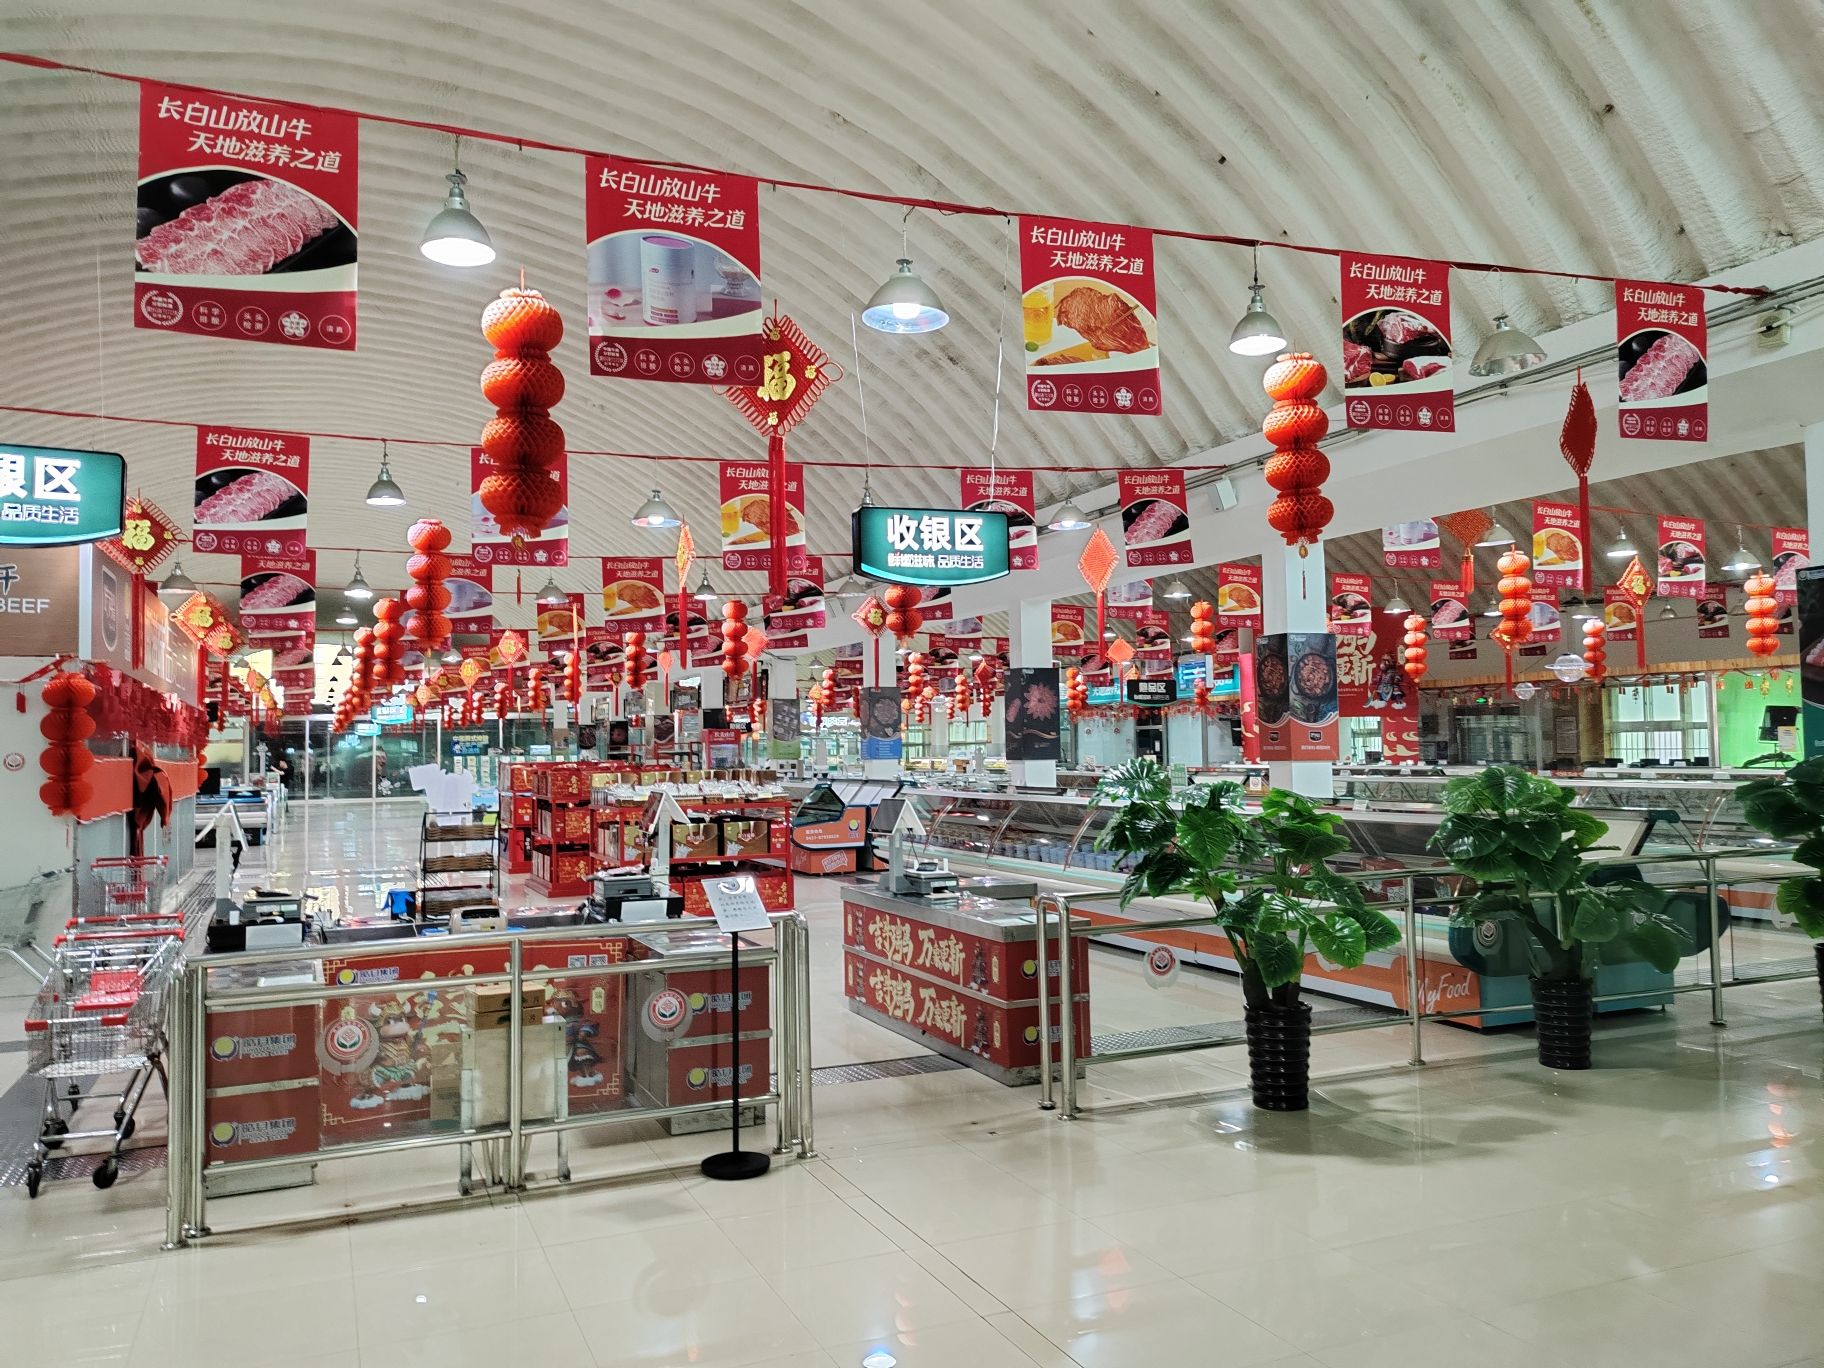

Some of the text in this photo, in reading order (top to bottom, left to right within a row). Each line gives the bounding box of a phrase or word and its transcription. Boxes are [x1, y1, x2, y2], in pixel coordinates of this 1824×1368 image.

[157, 96, 312, 140] 长白山放山牛
[187, 131, 343, 173] 天地滋养之道
[599, 167, 721, 204] 长白山放山牛
[622, 198, 746, 230] 天地滋养之道
[1030, 226, 1126, 251] 长白山放山牛
[1050, 250, 1145, 275] 天地滋养之道
[1349, 261, 1427, 284] 长白山放山牛
[1365, 283, 1443, 306] 天地滋养之道
[1623, 287, 1686, 307] 长白山放山牛
[1637, 307, 1699, 327] 天地滋养之道
[206, 433, 285, 452] 长白山放山牛
[221, 449, 301, 468] 天地滋养之道
[977, 486, 1028, 497] 天地滋养之道
[1124, 475, 1170, 485] 长白山放山牛
[1134, 485, 1181, 495] 天地滋养之道
[1, 502, 79, 525] 品质生活
[121, 519, 155, 551] 福
[886, 514, 985, 551] 收银区
[937, 555, 985, 569] 品质生活
